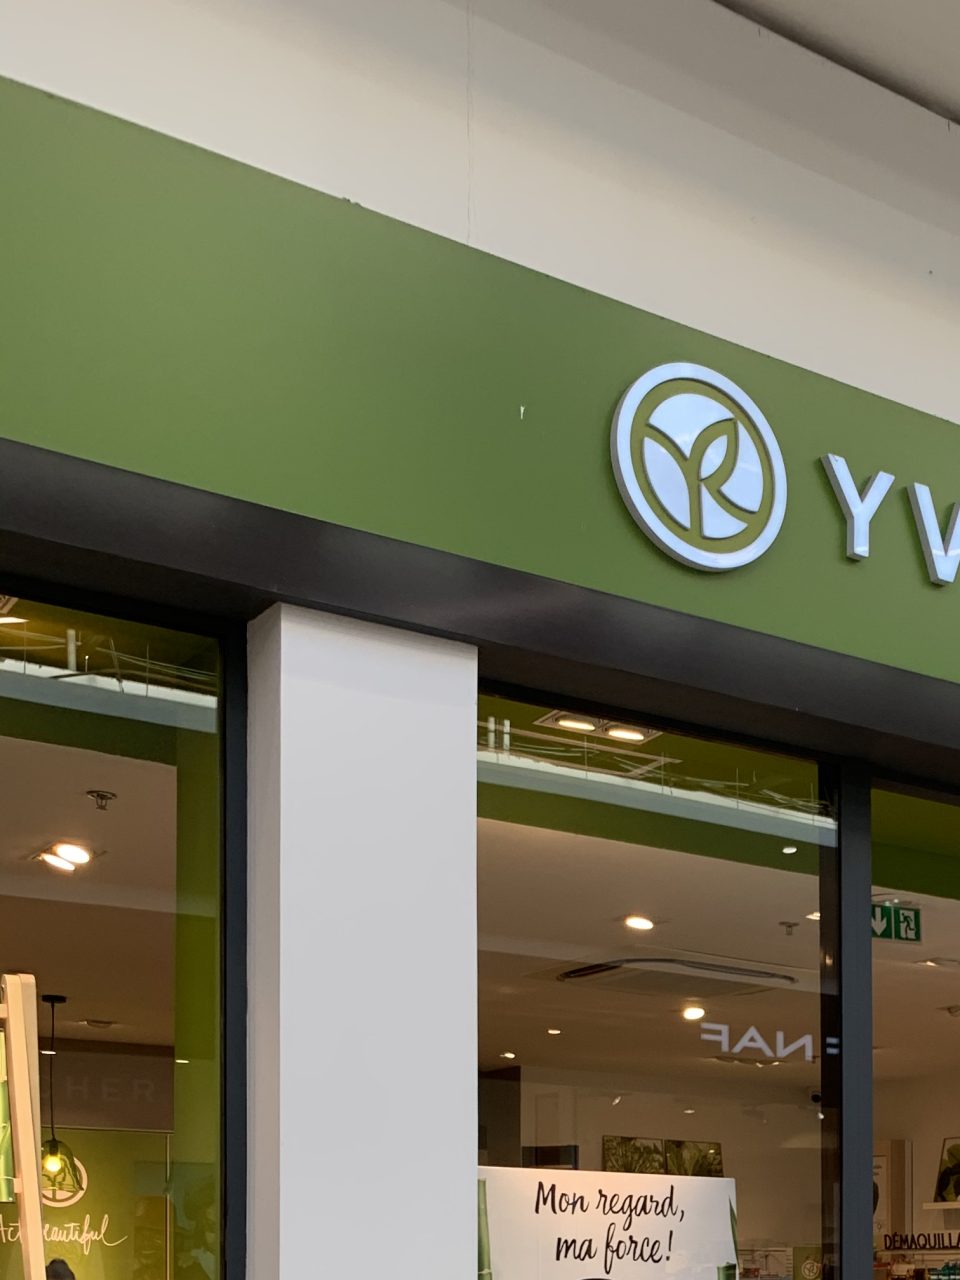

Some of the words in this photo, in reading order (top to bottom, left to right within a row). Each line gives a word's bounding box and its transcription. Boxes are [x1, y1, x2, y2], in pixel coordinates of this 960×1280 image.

[535, 1181, 590, 1214] Mon
[595, 1184, 685, 1231] regard,
[43, 1213, 128, 1256] eautiful
[555, 1237, 597, 1261] ma
[604, 1222, 673, 1275] force!
